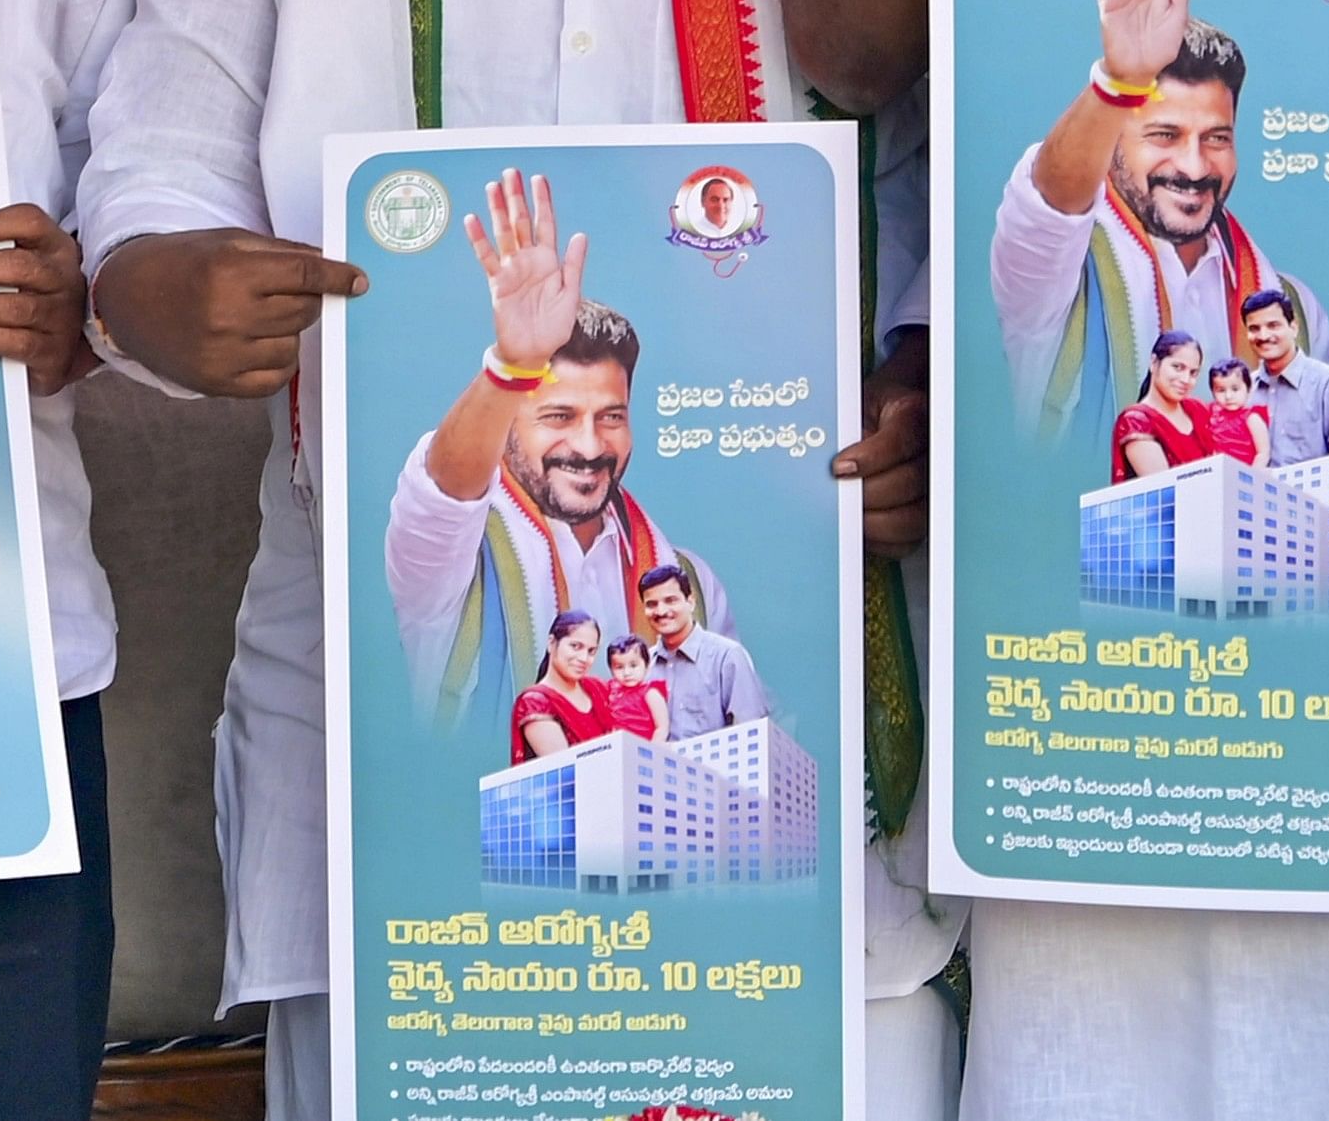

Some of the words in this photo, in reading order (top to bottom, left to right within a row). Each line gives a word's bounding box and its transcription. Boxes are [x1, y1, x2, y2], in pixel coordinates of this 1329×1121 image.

[1263, 107, 1329, 139] ప్రజల
[1262, 149, 1318, 181] ప్రజా
[657, 383, 723, 415] ప్రజల
[728, 376, 808, 406] సేవలో
[657, 425, 712, 457] ప్రజా
[718, 423, 825, 456] ప్రభుత్వం
[985, 630, 1086, 663] రాజీవ్
[1096, 632, 1248, 680] ఆరోగ్యశ్రీ
[986, 675, 1050, 721] వైద్య
[1060, 680, 1174, 714] సాయం
[1184, 687, 1246, 717] రూ.
[1258, 688, 1294, 719] 10
[985, 727, 1043, 754] ఆరోగ్య
[1048, 732, 1129, 752] తెలంగాణ
[1134, 736, 1169, 759] వైపు
[1174, 736, 1217, 756] మరో
[1222, 740, 1283, 758] అడుగు
[1002, 774, 1071, 796] రాష్ట్రంలోని
[1155, 783, 1223, 798] ఉచితంగా
[1002, 805, 1031, 823] అన్ని
[1033, 804, 1073, 821] రాజీవ్
[1076, 806, 1132, 829] ఆరోగ్యశ్రీ
[1001, 831, 1052, 850] ప్రజలకు
[1055, 837, 1123, 856] ఇబ్బందులు
[1126, 836, 1183, 854] లేకుండా
[1186, 840, 1252, 857] అమలులో
[386, 912, 488, 944] రాజీవ్
[498, 910, 650, 956] ఆరోగ్యశ్రీ
[388, 959, 453, 1002] వైద్య
[462, 961, 577, 991] సాయం
[587, 962, 649, 991] రూ.
[660, 961, 696, 991] 10
[706, 960, 801, 999] లక్షలు
[387, 1010, 447, 1036] ఆరోగ్య
[451, 1013, 533, 1030] తెలంగాణ
[538, 1013, 573, 1035] వైపు
[577, 1010, 621, 1030] మరో
[625, 1012, 686, 1030] అడుగు
[405, 1055, 475, 1078] రాష్ట్రంలోని
[559, 1059, 627, 1073] ఉచితంగా
[694, 1057, 734, 1076] వైద్యం
[406, 1087, 436, 1105] అన్ని
[437, 1084, 478, 1100] రాజీవ్
[481, 1084, 537, 1106] ఆరోగ్యశ్రీ
[690, 1081, 743, 1103] తక్షణమే
[745, 1084, 793, 1097] అమలు
